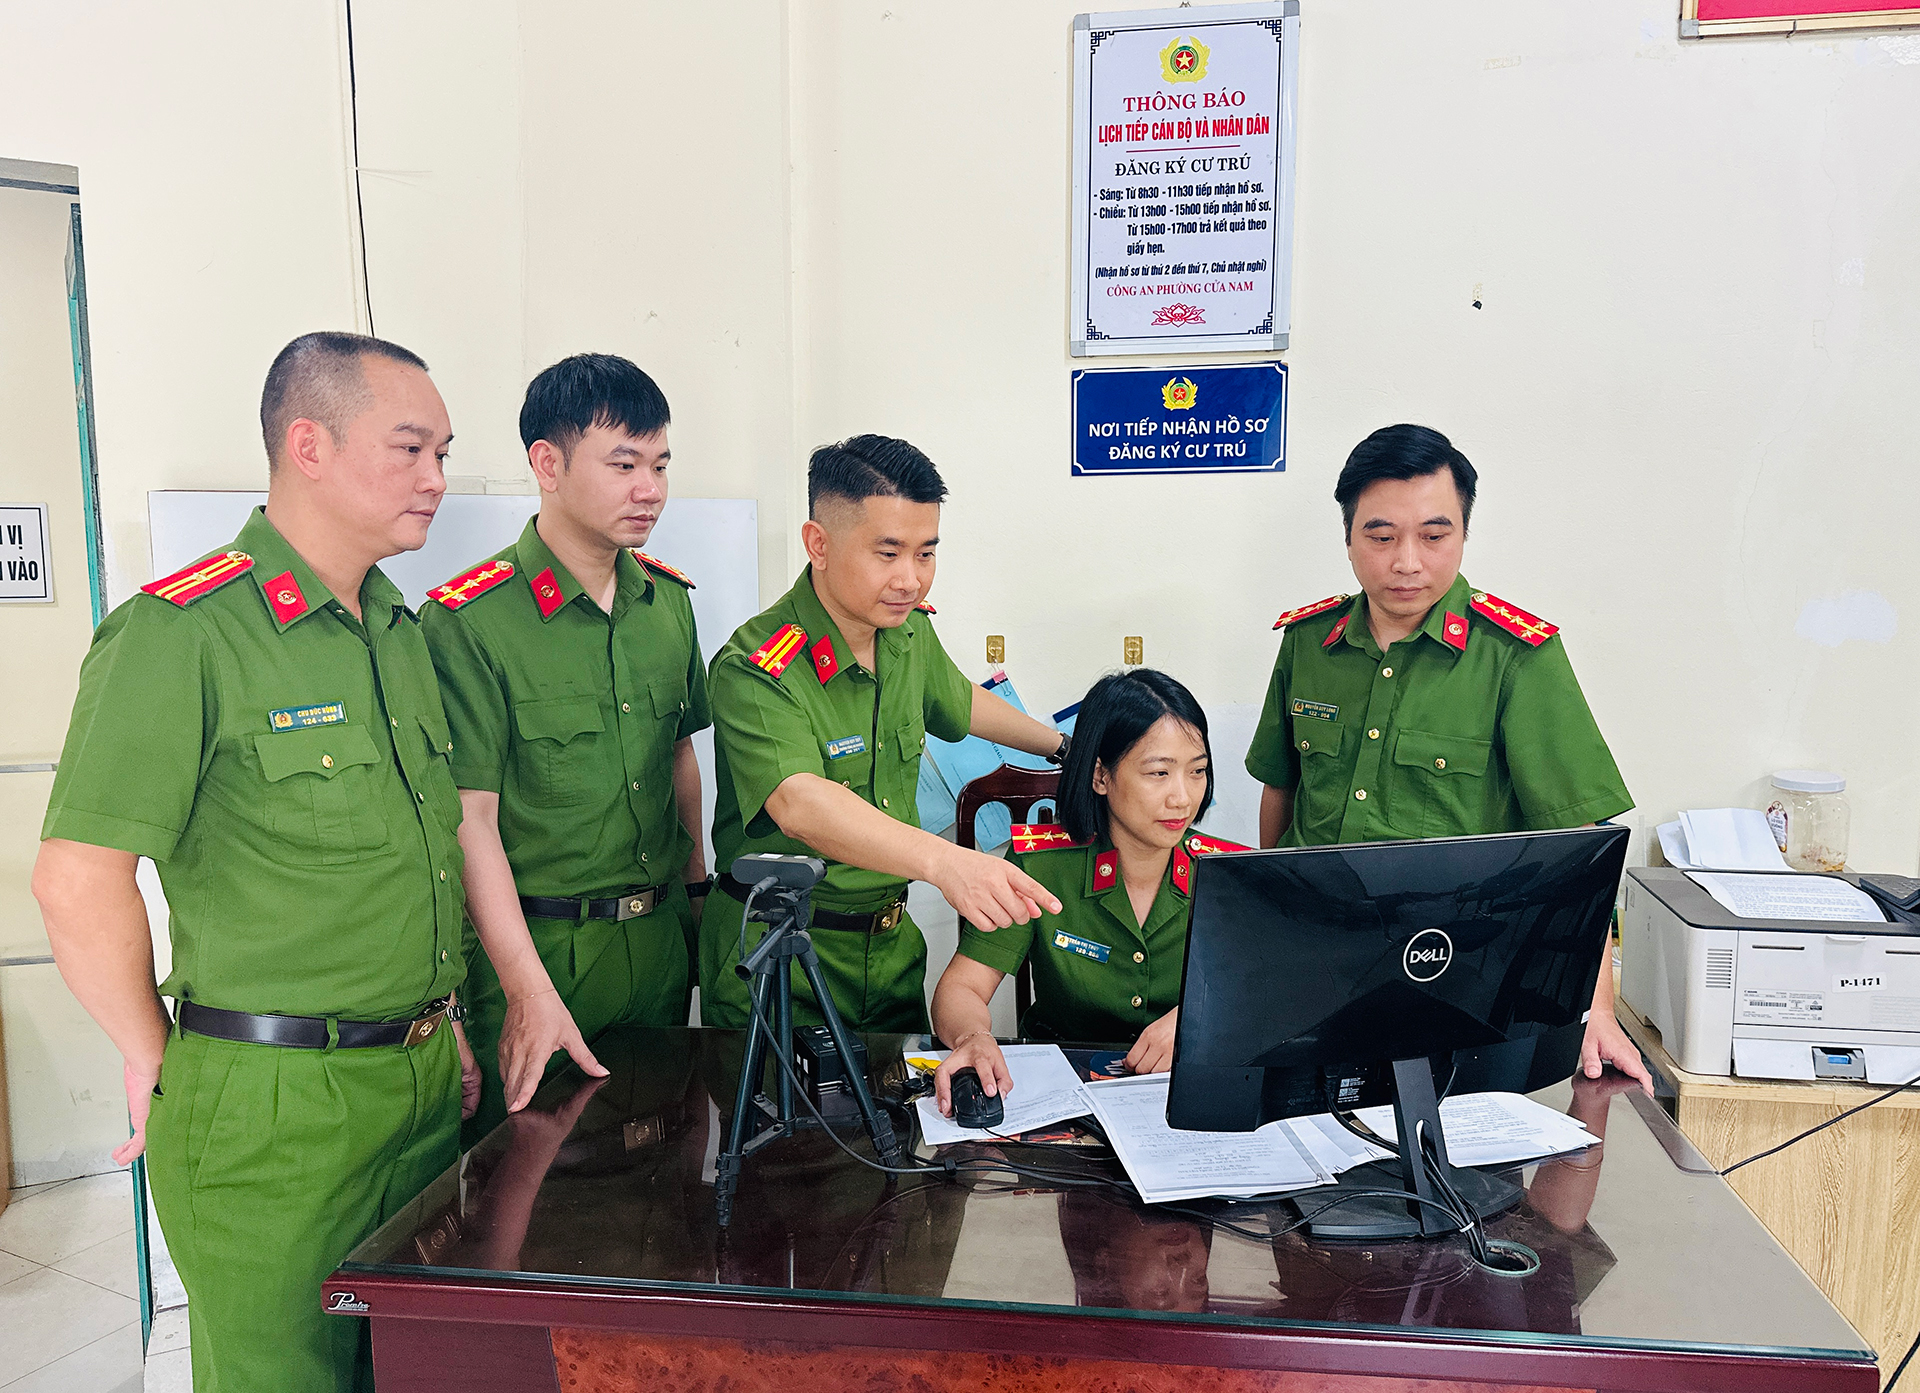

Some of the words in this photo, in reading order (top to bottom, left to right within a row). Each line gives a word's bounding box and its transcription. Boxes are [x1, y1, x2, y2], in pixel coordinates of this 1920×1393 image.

[1123, 91, 1196, 112] THÔNG
[1203, 87, 1245, 108] BÁO
[1099, 123, 1123, 146] LỊCH
[1126, 117, 1149, 141] TIẾP
[1151, 118, 1174, 140] CÁN
[1177, 117, 1194, 142] BỘ
[1195, 116, 1209, 138] VÀ
[1212, 115, 1243, 137] NHÂN
[1246, 113, 1270, 135] DÂN
[1115, 160, 1160, 176] ĐĂNG
[1165, 156, 1185, 174] KÝ
[1191, 157, 1214, 172] CƯ
[1217, 153, 1251, 170] TRÚ
[1099, 188, 1124, 201] Sáng:
[1126, 186, 1136, 199] Từ
[1138, 186, 1159, 199] 8h30
[1195, 182, 1212, 197] tiếp
[1214, 182, 1235, 197] nhận
[1238, 180, 1249, 194] hồ
[1251, 182, 1264, 193] sơ.
[1099, 204, 1126, 219] Chiều:
[1128, 205, 1138, 217] Từ
[1140, 204, 1166, 217] 13h00
[1203, 200, 1219, 215] tiếp
[1222, 200, 1243, 215] nhận
[1245, 198, 1257, 212] hồ
[1258, 200, 1272, 211] sơ.
[1127, 223, 1138, 236] Từ
[1139, 223, 1165, 236] 15h00
[1199, 219, 1211, 233] trả
[1213, 218, 1227, 232] kết
[1229, 217, 1245, 233] quả
[1248, 219, 1267, 231] theo
[1127, 240, 1145, 256] giấy
[1147, 243, 1165, 256] hẹn.
[1095, 266, 1117, 280] (Nhận
[1119, 265, 1130, 276] hồ
[1130, 267, 1140, 276] sơ
[1141, 264, 1150, 276] từ
[1151, 264, 1164, 276] thứ
[1164, 265, 1170, 275] 2
[1172, 262, 1186, 275] đến
[1188, 262, 1201, 274] thứ
[1202, 263, 1209, 275] 7,
[1211, 260, 1226, 273] Chủ
[1227, 260, 1245, 274] nhật
[1106, 284, 1137, 297] CÔNG
[1139, 285, 1155, 295] AN
[1157, 281, 1201, 295] PHƯỜNG
[1204, 279, 1226, 293] CỬA
[1228, 281, 1254, 292] NAM
[1089, 422, 1120, 437] NƠI
[1124, 416, 1158, 437] TIẾP
[1162, 417, 1210, 438] NHẬN
[1215, 414, 1240, 434] HỒ
[1244, 417, 1270, 433] SƠ
[1108, 442, 1156, 460] ĐĂNG
[1160, 441, 1181, 459] KÝ
[1184, 443, 1210, 458] CƯ
[1213, 439, 1247, 457] TRÚ
[7, 525, 23, 550] VỊ
[7, 556, 39, 581] VÀO
[1410, 948, 1447, 963] DELL
[1840, 977, 1880, 987] P-1471
